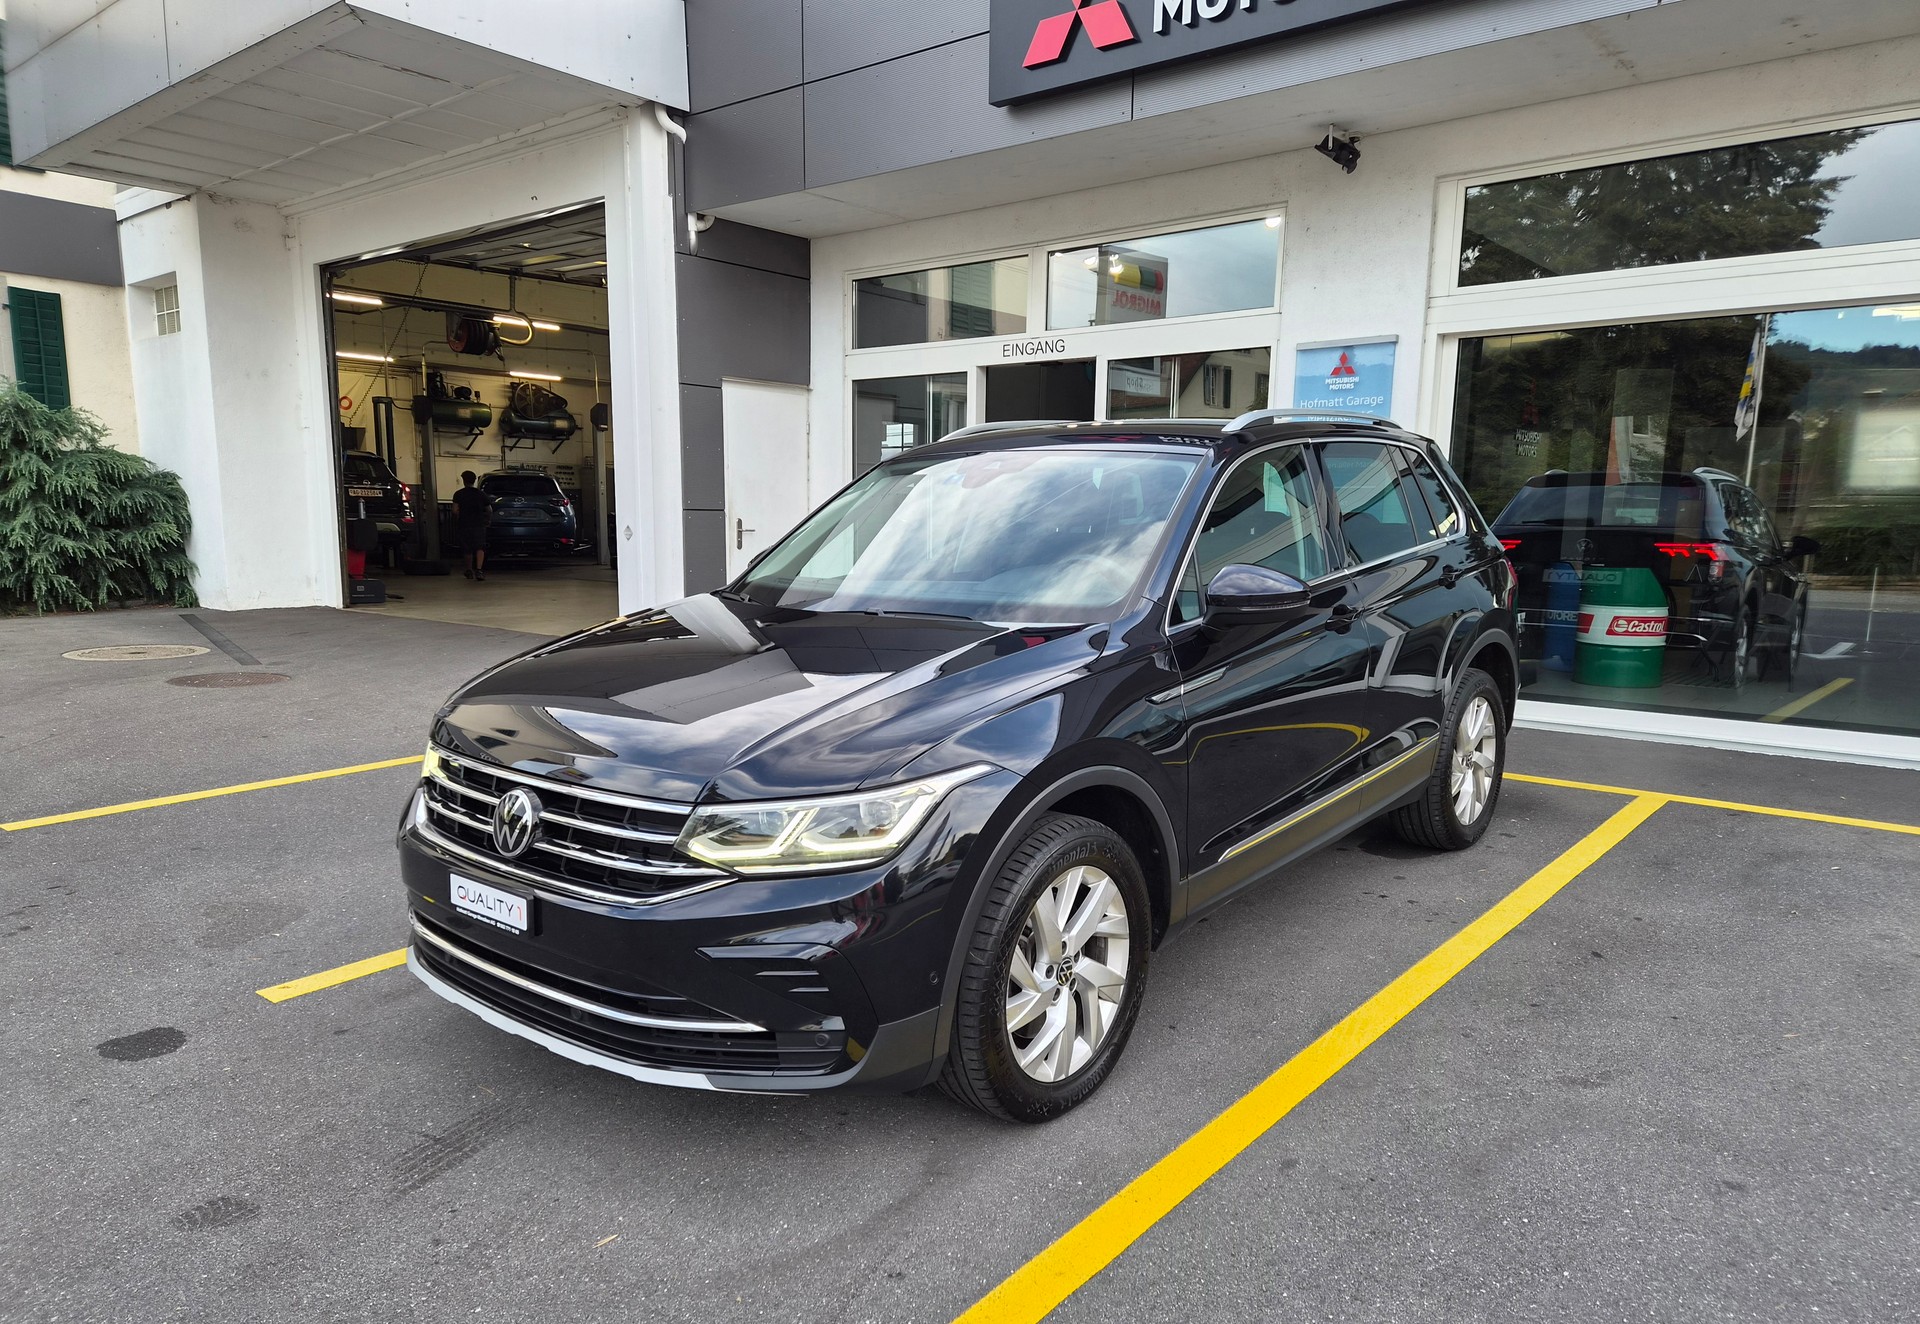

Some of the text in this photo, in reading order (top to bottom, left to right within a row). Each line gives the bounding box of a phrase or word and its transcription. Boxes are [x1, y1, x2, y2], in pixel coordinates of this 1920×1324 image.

[1002, 339, 1065, 357] EINGANG
[1325, 376, 1360, 384] MITSUBISHI
[1329, 383, 1354, 391] MOTORS
[1300, 396, 1384, 409] Hofmatt Garage
[1627, 620, 1665, 633] Castrol
